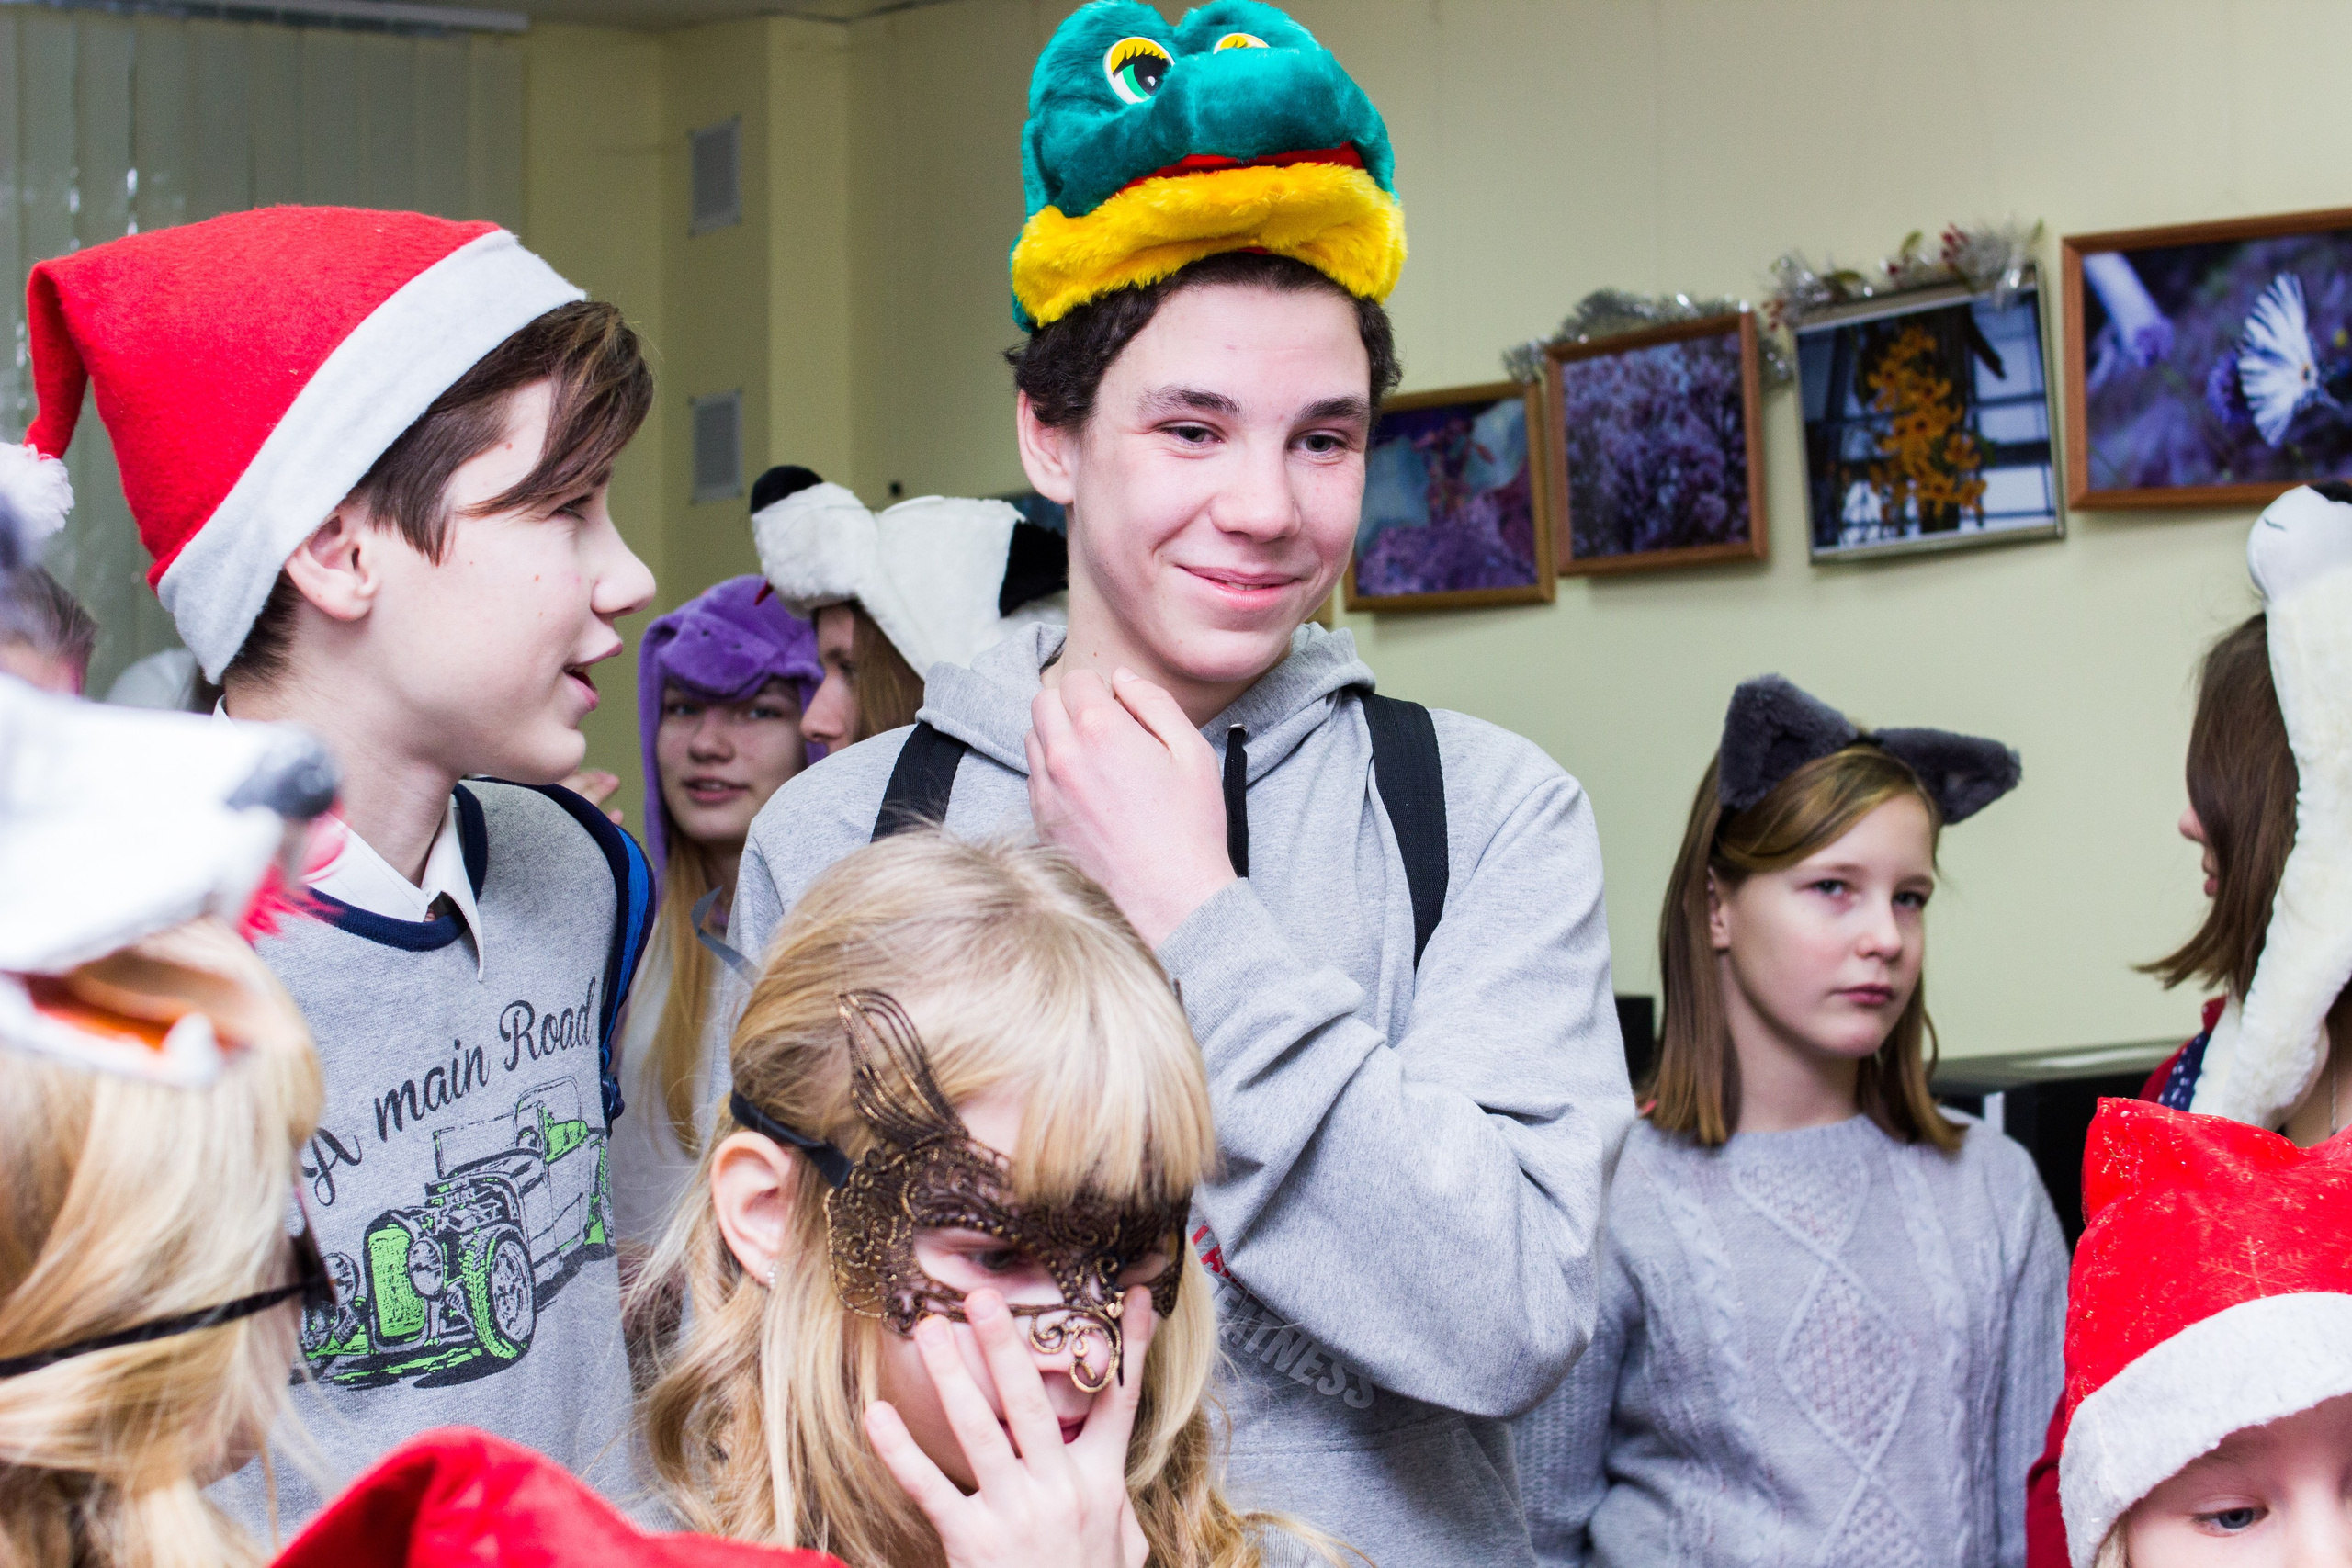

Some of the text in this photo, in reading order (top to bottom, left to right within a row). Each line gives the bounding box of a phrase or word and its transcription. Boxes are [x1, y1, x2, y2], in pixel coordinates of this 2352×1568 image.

[303, 976, 596, 1207] A main Road
